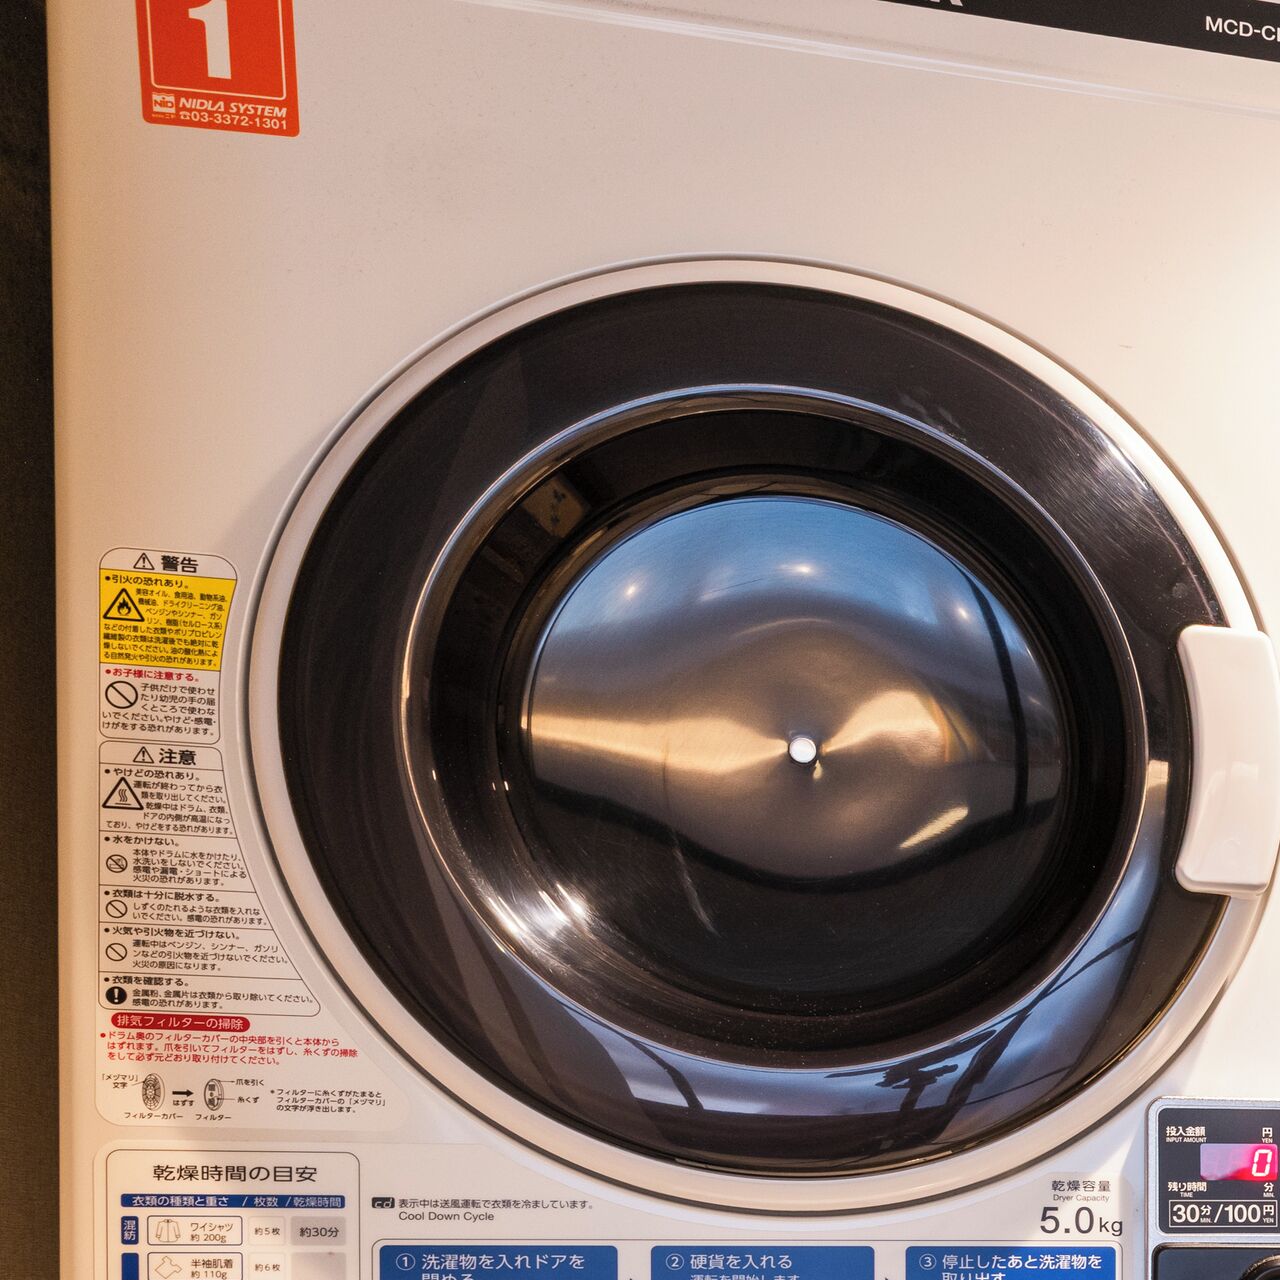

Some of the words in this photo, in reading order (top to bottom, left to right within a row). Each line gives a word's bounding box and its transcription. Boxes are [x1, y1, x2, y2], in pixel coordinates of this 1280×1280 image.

[188, 0, 231, 79] 1
[179, 97, 225, 112] NIDLA
[230, 103, 287, 118] SYSTEM
[191, 111, 287, 130] 03-3372-1301
[161, 555, 199, 574] 警告
[158, 747, 196, 765] 注意
[117, 1013, 244, 1031] 排気フィルターの掃除
[1261, 1127, 1273, 1138] 円
[1251, 1149, 1273, 1177] 0
[153, 1164, 318, 1183] 乾燥時間の目安
[1263, 1182, 1275, 1192] 分
[398, 1212, 425, 1222] Cool
[428, 1212, 461, 1222] Down
[463, 1212, 495, 1224] Cycle
[299, 1227, 340, 1239] 約30分
[421, 1253, 586, 1271] 洗濯物を入れドアを
[690, 1253, 792, 1270] 硬貨を入れる
[942, 1253, 1102, 1271] 停止したあと洗濯物を
